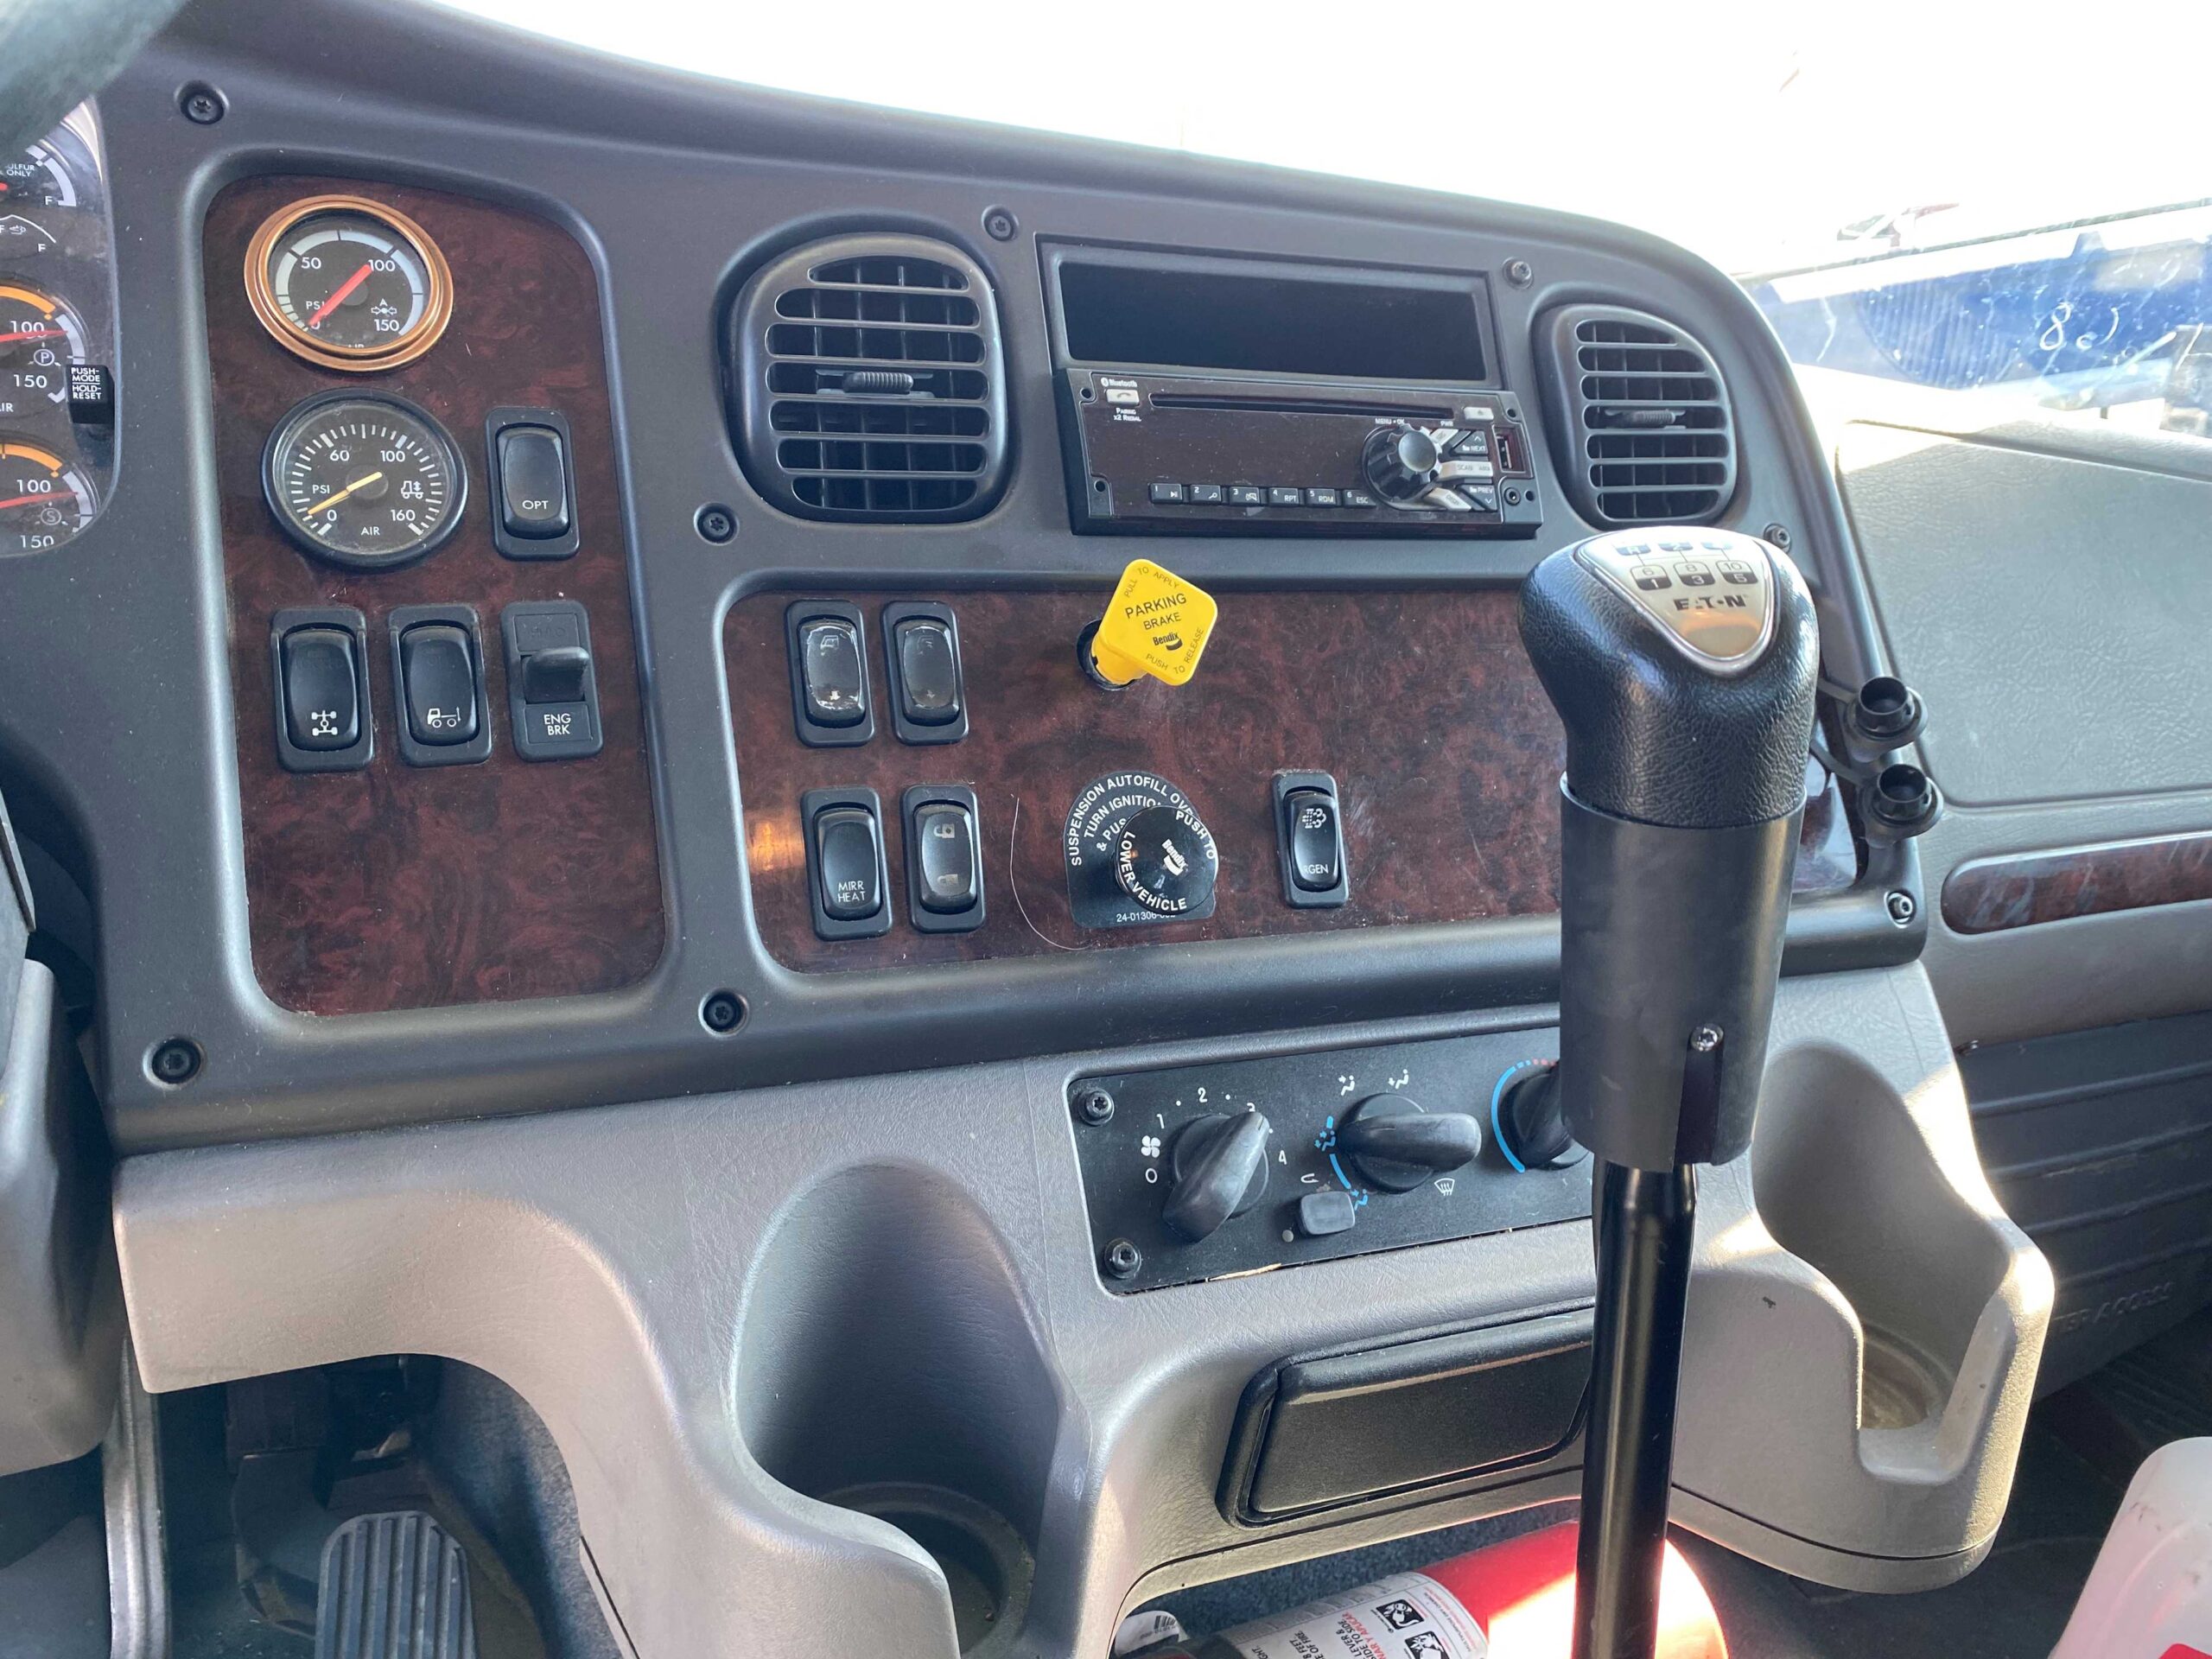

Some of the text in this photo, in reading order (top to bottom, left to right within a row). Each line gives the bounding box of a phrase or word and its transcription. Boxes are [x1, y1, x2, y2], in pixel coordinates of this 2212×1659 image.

[6, 168, 32, 177] ONLY
[45, 195, 53, 206] F
[38, 244, 46, 252] F
[301, 257, 322, 270] 50
[367, 259, 396, 272] 100
[306, 300, 325, 310] PSI
[379, 298, 387, 307] A
[10, 320, 45, 340] 100
[374, 319, 400, 332] 150
[71, 367, 100, 376] PUSH-
[14, 374, 48, 389] 150
[72, 374, 100, 383] MODE
[1109, 378, 1138, 388] Bluetooth
[73, 391, 101, 400] RESET
[329, 449, 350, 461] 60
[380, 449, 406, 462] 100
[16, 479, 51, 493] 100
[312, 484, 330, 494] PSI
[522, 499, 549, 510] OPT
[1318, 494, 1335, 503] RDM
[327, 509, 337, 521] 0
[391, 509, 416, 521] 160
[361, 526, 381, 536] AIR
[21, 534, 54, 548] 150
[1642, 568, 1654, 576] 6
[1723, 563, 1742, 571] 10
[1124, 566, 1179, 598] PULL TO APPLY
[1650, 574, 1747, 588] 1 3 5
[1125, 593, 1187, 619] PARKING
[1143, 612, 1182, 631] BRAKE
[1153, 632, 1179, 646] Bendix
[1146, 627, 1204, 675] PUSH TO RELEASE
[543, 713, 571, 725] ENG
[547, 724, 570, 735] BRK
[1068, 783, 1105, 866] SUSPENSION
[1107, 774, 1167, 797] AUTOFILL
[1084, 794, 1161, 838] TURN IGNITIO
[1096, 817, 1127, 852] & PUS
[1176, 810, 1217, 859] PUSH TO
[1161, 838, 1189, 869] Bendix
[1119, 830, 1187, 911] LOWER VEHICLE
[838, 880, 864, 892] MIRR
[837, 891, 866, 903] HEAT
[1116, 911, 1176, 923] 24-01306-
[1198, 1087, 1207, 1103] 2
[1156, 1113, 1165, 1129] 1
[1278, 1150, 1287, 1165] 4
[1145, 1167, 1158, 1184] 0
[1351, 1633, 1363, 1644] TO
[1306, 1644, 1319, 1654] OF
[1341, 1635, 1362, 1657] LEVER
